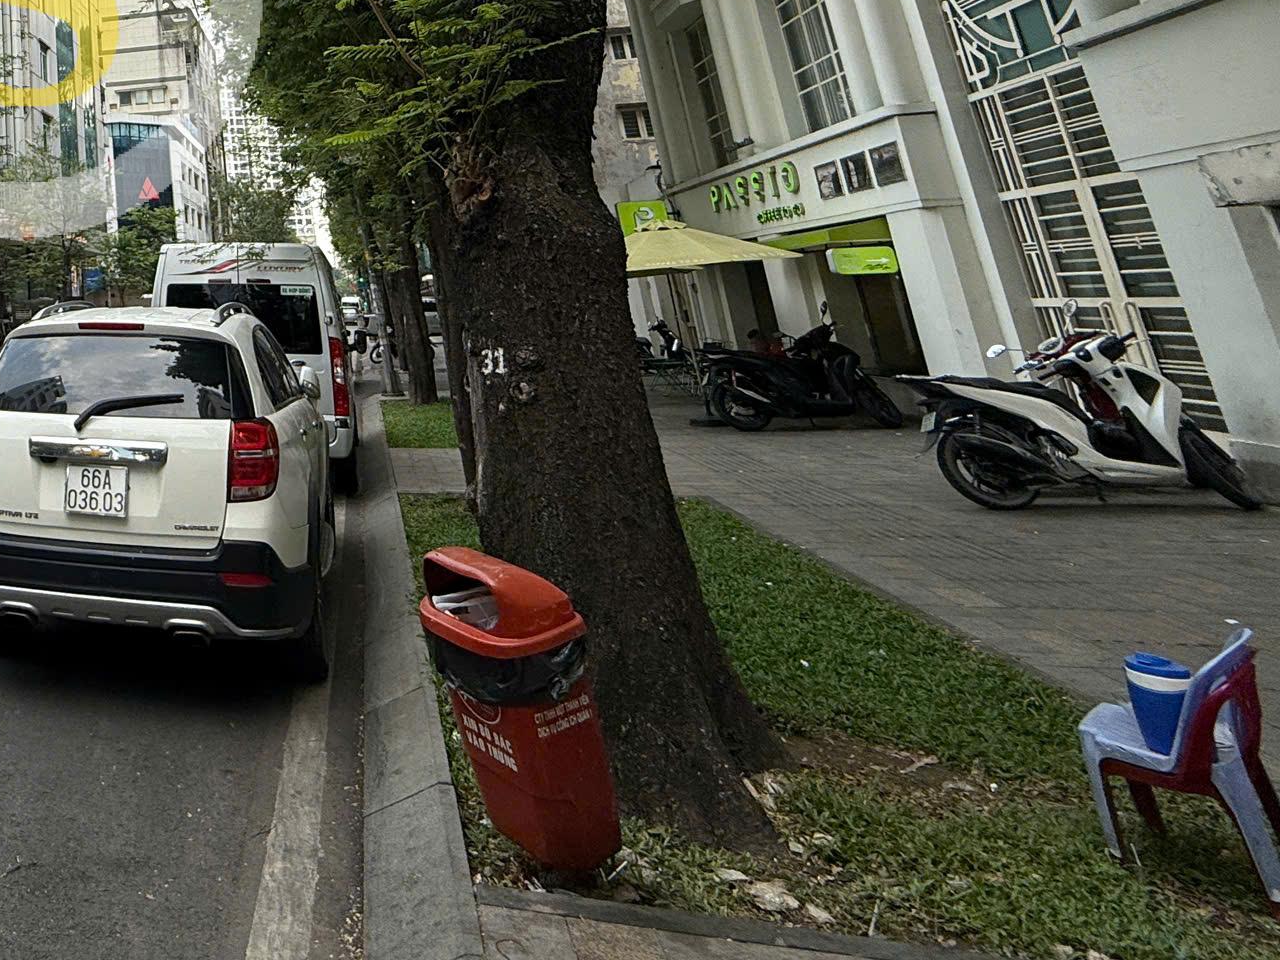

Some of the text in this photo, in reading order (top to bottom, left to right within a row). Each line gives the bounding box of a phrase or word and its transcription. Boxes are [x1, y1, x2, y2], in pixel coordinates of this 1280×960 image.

[256, 265, 304, 273] LUXURY
[81, 468, 111, 490] 66A
[68, 489, 123, 512] 036.03
